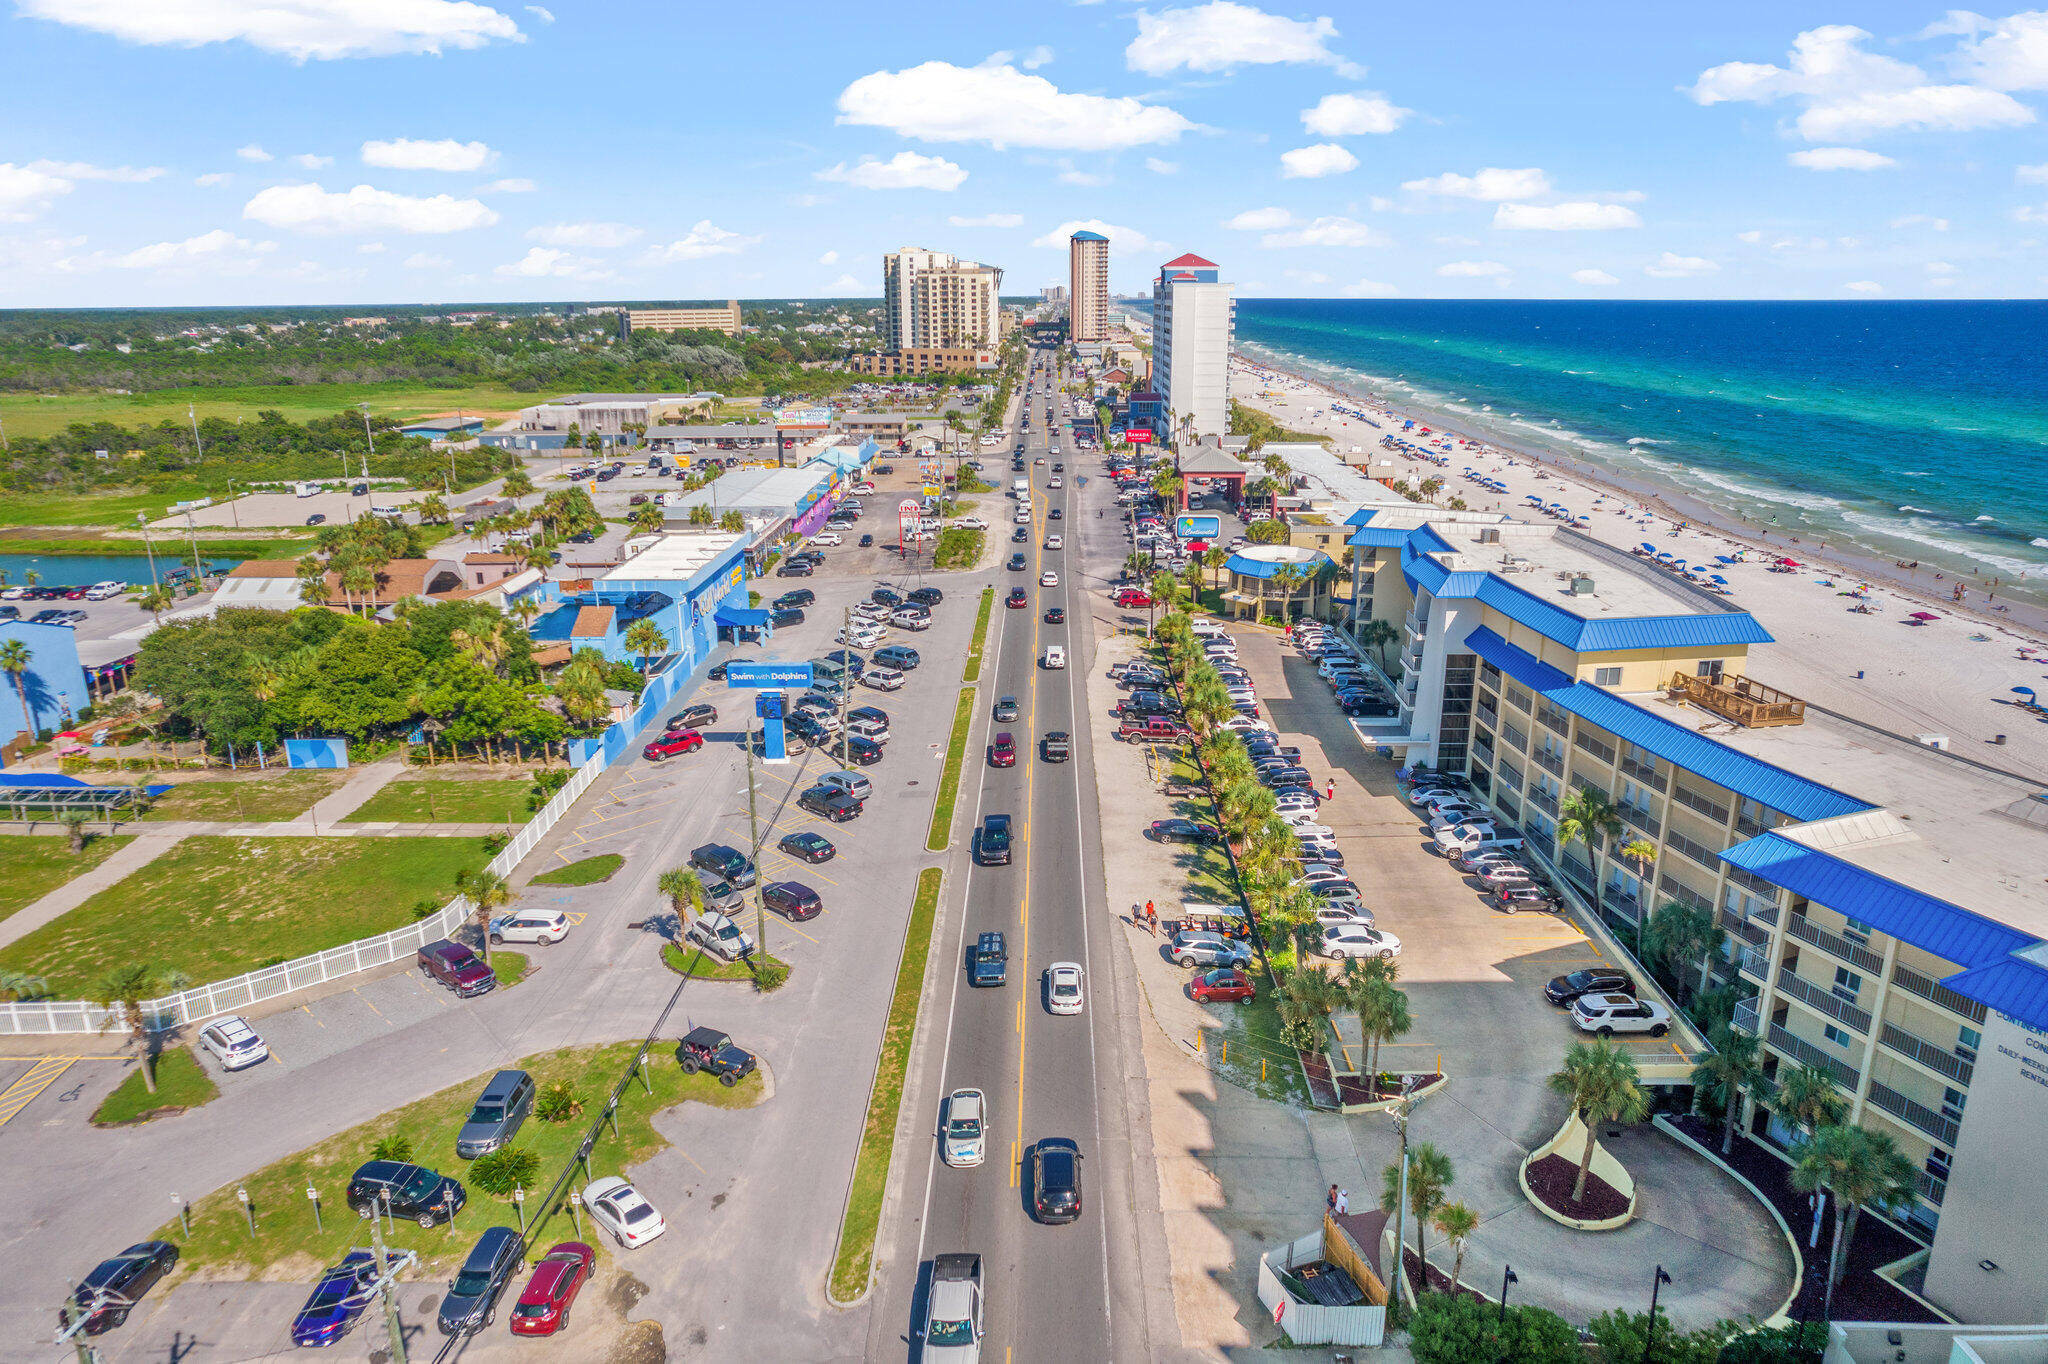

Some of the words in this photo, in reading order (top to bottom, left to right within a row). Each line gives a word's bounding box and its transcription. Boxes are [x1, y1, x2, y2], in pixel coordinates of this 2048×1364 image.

[1184, 528, 1216, 536] Continental
[731, 672, 755, 681] Swim
[755, 673, 771, 681] with
[771, 672, 808, 682] Dolphins
